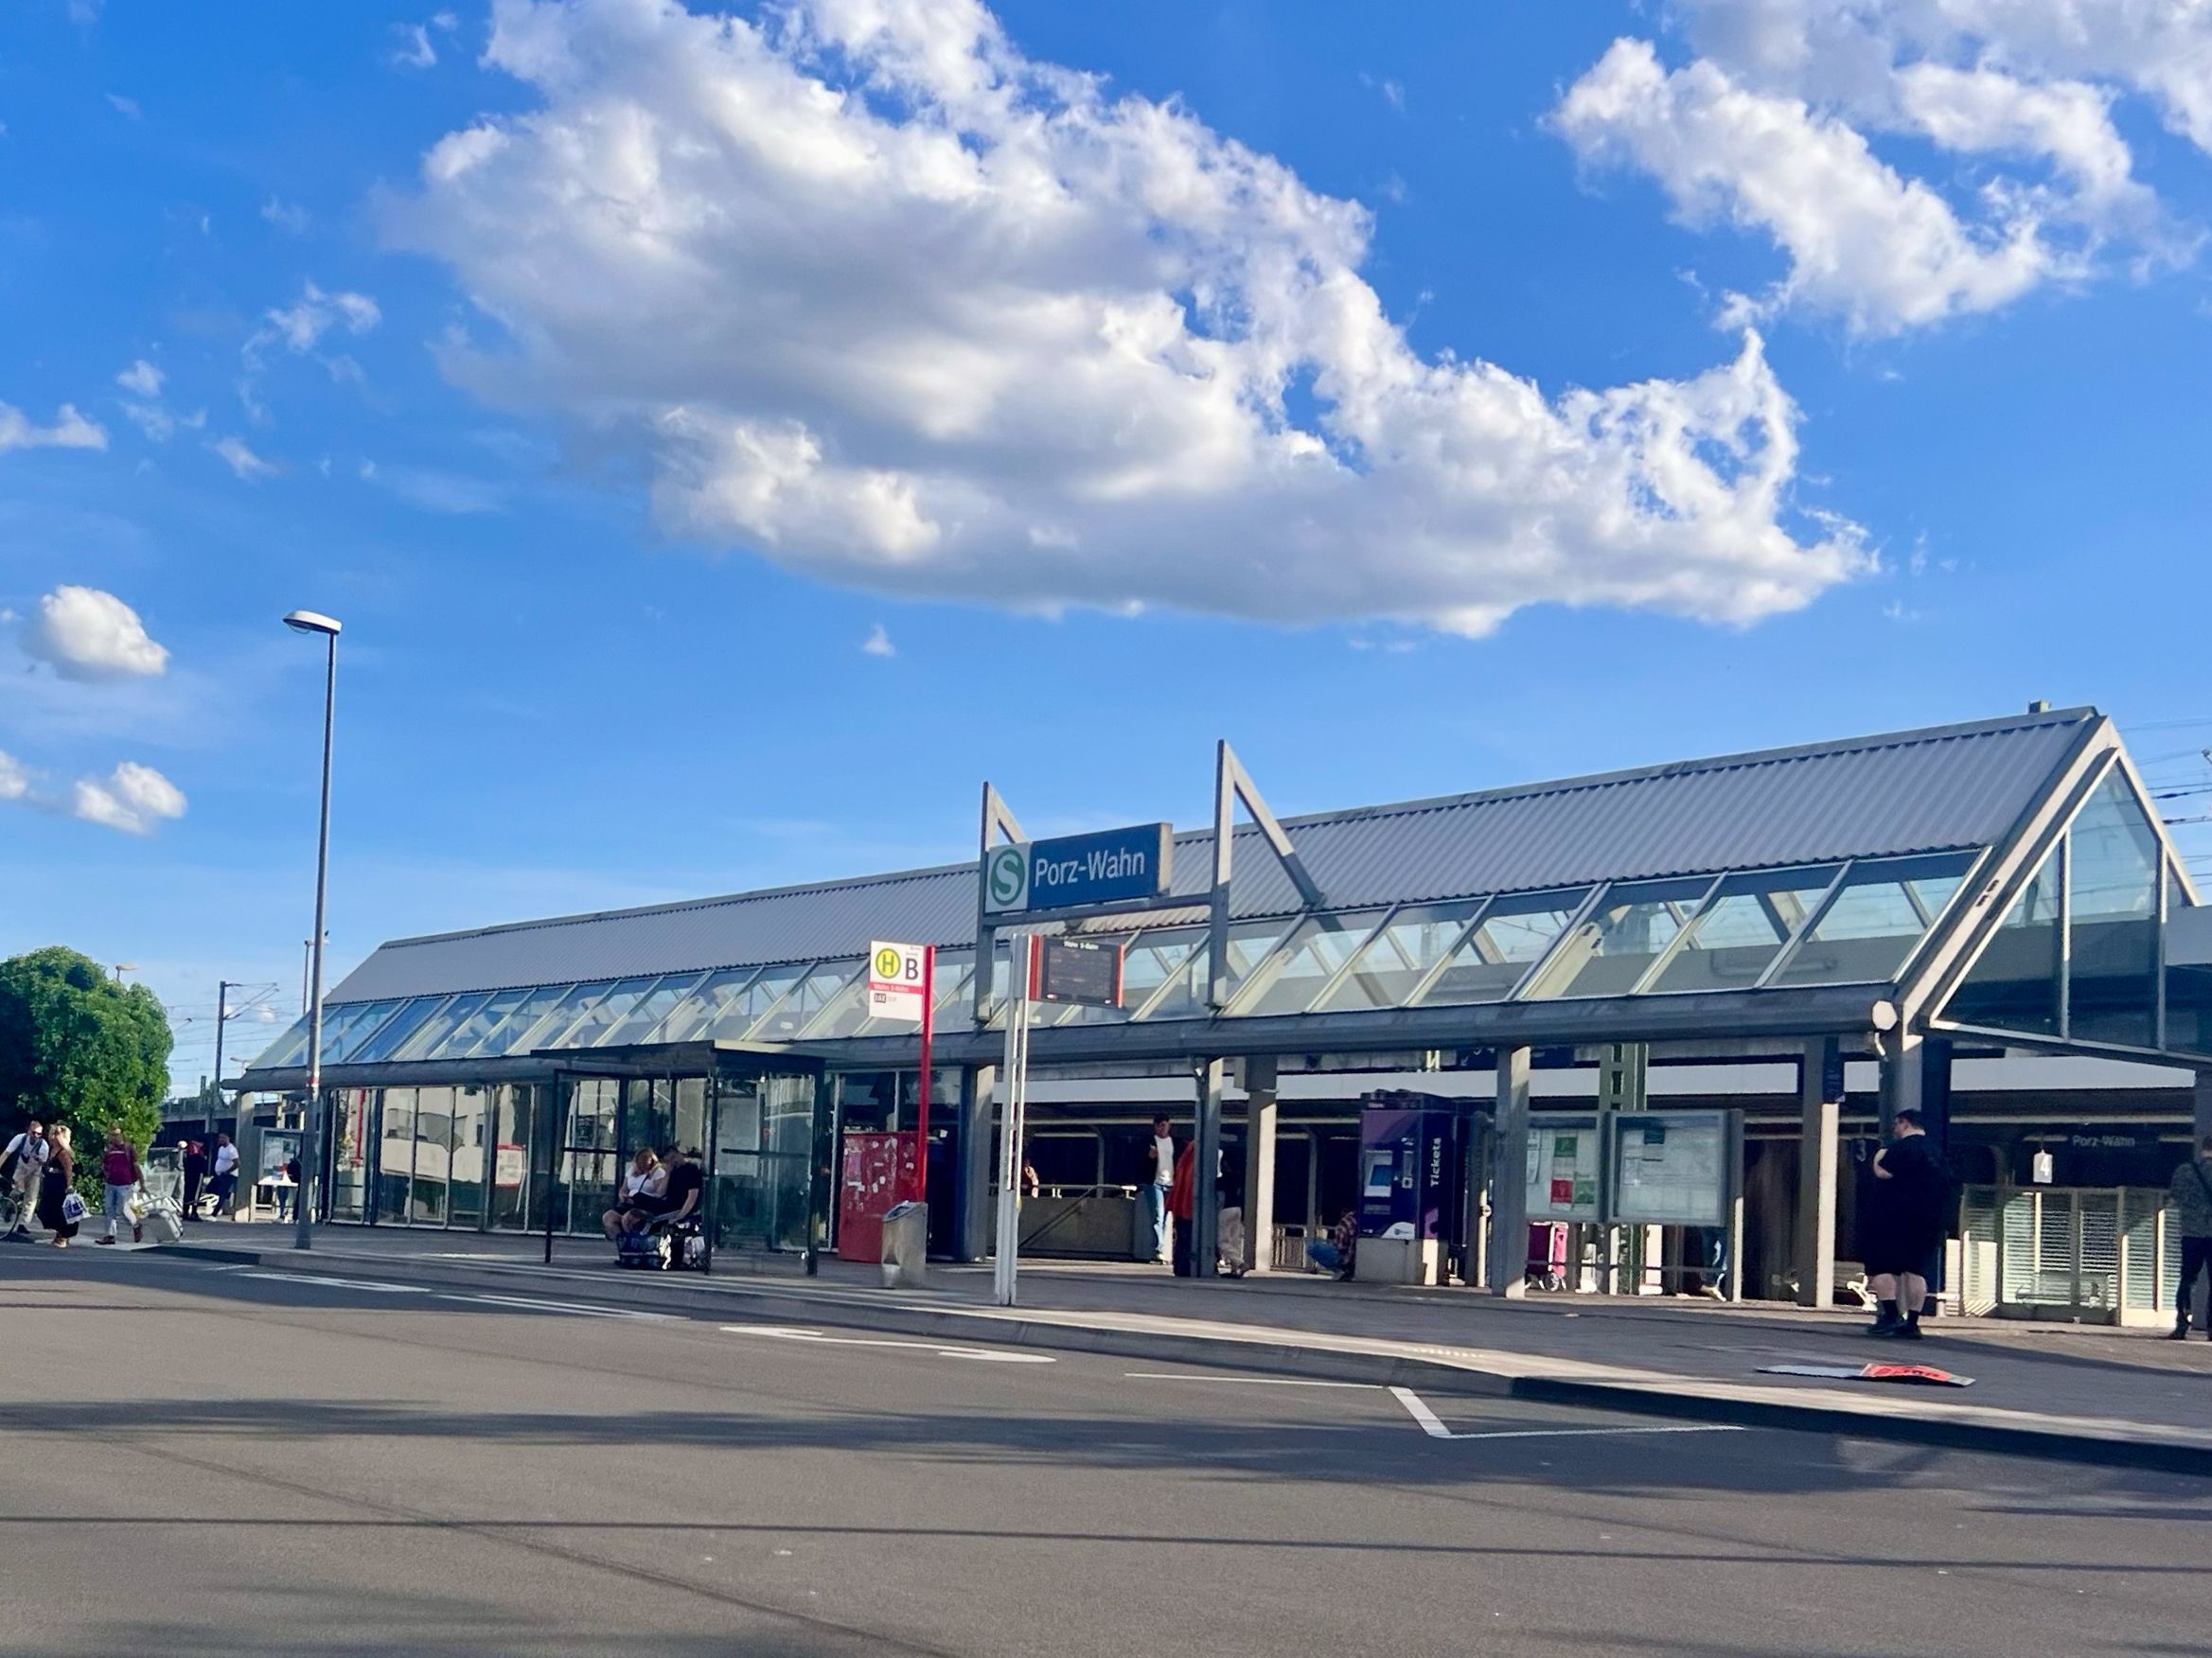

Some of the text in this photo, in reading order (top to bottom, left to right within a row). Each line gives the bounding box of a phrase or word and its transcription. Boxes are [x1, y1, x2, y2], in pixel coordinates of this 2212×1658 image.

[995, 846, 1145, 903] S Porz-Wahn
[882, 953, 894, 974] H
[905, 958, 919, 980] B
[1430, 1138, 1442, 1188] Tickets
[2040, 1155, 2050, 1176] 4
